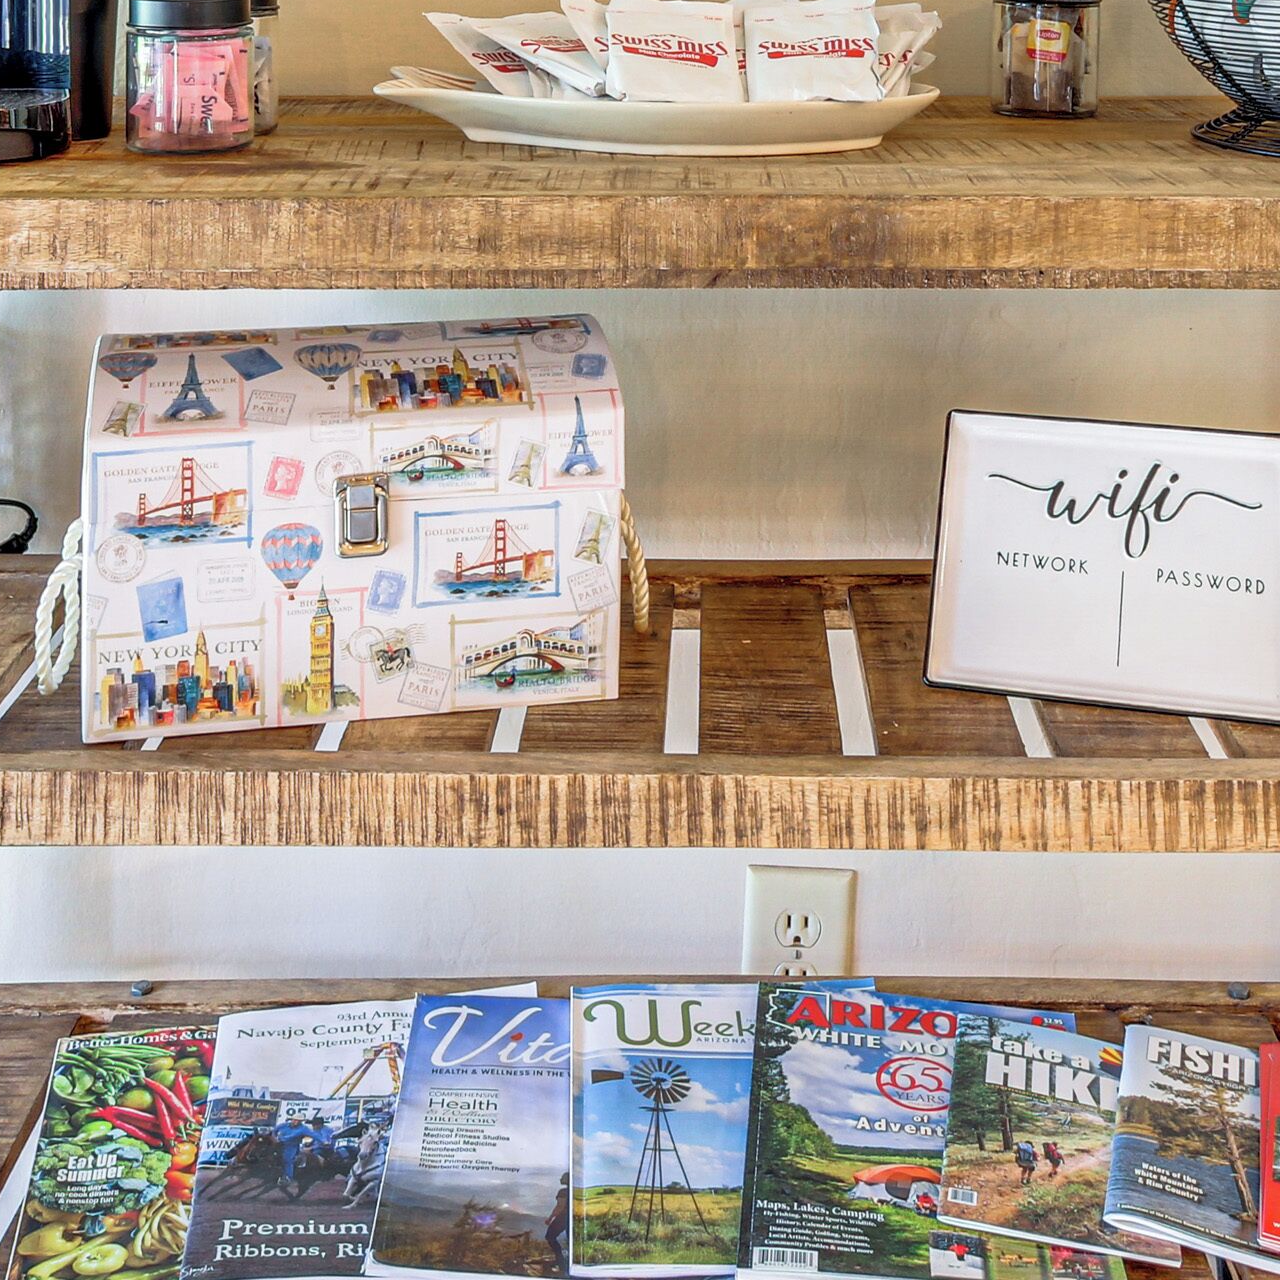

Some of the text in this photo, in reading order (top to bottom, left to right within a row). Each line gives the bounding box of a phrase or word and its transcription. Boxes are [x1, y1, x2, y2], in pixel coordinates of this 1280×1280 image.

[1038, 30, 1059, 38] Lipton
[357, 352, 520, 368] NEW CITY
[253, 404, 286, 414] PARIS
[103, 468, 150, 478] GOLDEN
[988, 460, 1263, 559] wifi
[425, 527, 465, 537] GOLDEN
[996, 551, 1089, 575] NETWORK
[1156, 568, 1266, 595] PASSWORD
[578, 583, 609, 602] PARIS
[299, 599, 317, 608] BIG
[98, 648, 144, 664] NEW
[215, 639, 263, 654] CITY
[407, 681, 440, 697] PARIS
[337, 1012, 366, 1021] 93rd
[583, 999, 755, 1047] Week
[120, 1032, 177, 1045] Homes
[181, 1032, 193, 1040] &
[237, 1022, 383, 1039] Navajo County
[794, 1026, 881, 1048] WHITE
[300, 1036, 376, 1048] September
[991, 1036, 1090, 1070] take a
[890, 1063, 943, 1092] 65
[428, 1098, 497, 1110] Health
[894, 1091, 946, 1104] YEARS
[913, 1115, 929, 1123] of
[68, 1154, 117, 1169] Eat Up
[57, 1166, 125, 1182] Summer
[1141, 1162, 1197, 1184] Waters of the
[1134, 1168, 1204, 1195] White Mountains
[1146, 1179, 1163, 1190] Rim
[1164, 1184, 1199, 1201] Country
[756, 1200, 885, 1222] Maps, Lakes, Camping
[219, 1219, 369, 1241] Premium
[792, 1227, 814, 1235] Guide,
[802, 1221, 831, 1229] Calendar
[213, 1243, 327, 1262] Ribbons,
